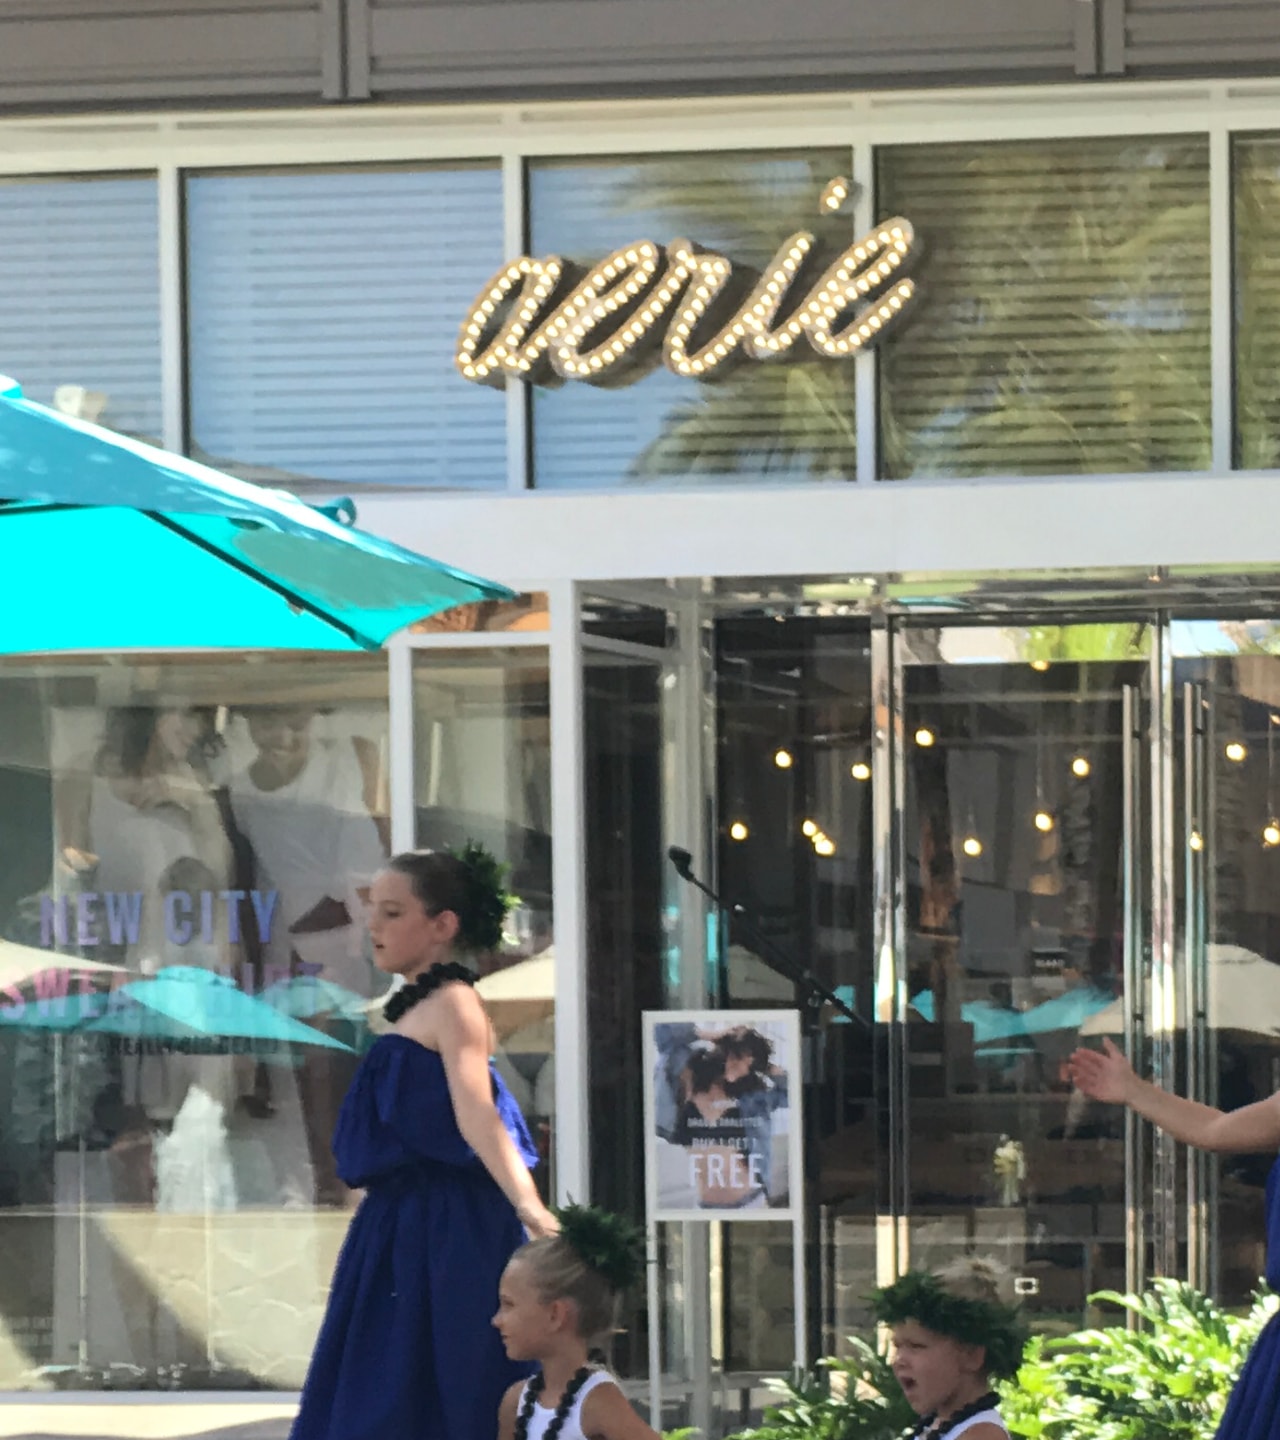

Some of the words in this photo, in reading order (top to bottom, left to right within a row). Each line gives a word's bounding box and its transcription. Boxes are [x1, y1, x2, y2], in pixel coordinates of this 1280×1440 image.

[456, 175, 915, 378] aerie
[40, 891, 143, 946] NEW
[163, 890, 279, 945] CITY
[687, 1153, 765, 1188] FREE
